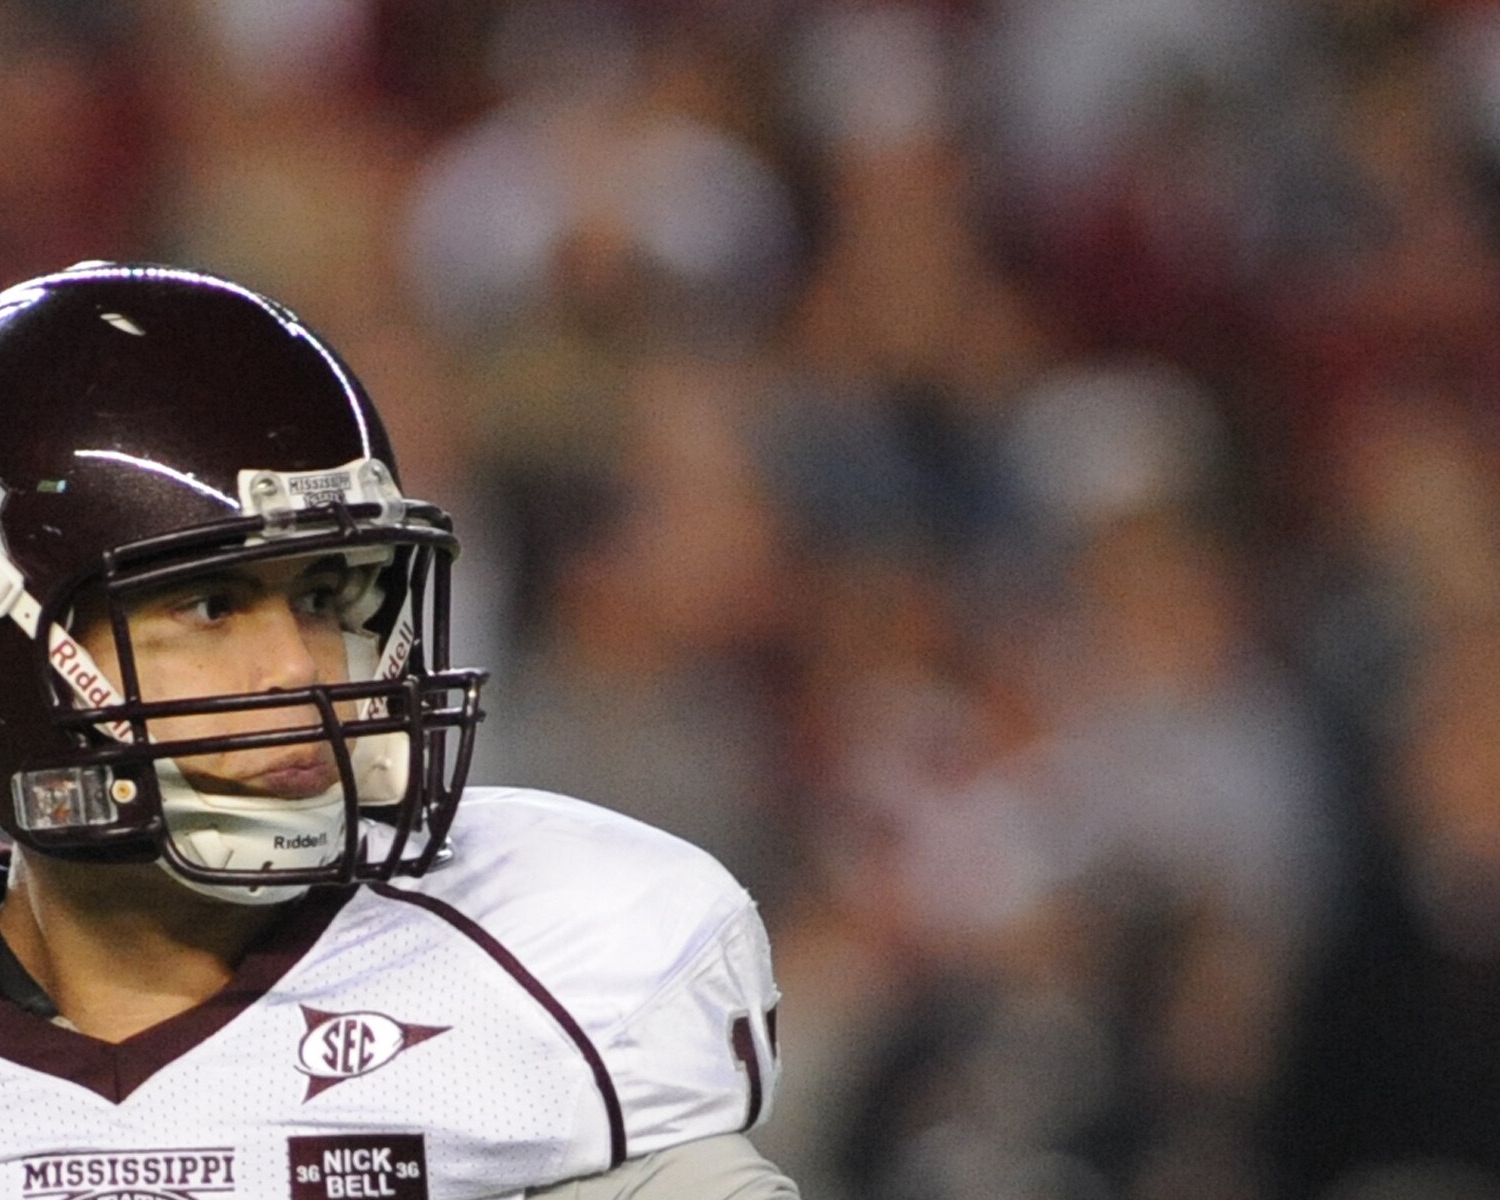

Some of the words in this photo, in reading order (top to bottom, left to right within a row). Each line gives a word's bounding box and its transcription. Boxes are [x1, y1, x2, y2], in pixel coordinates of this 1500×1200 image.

[274, 832, 328, 850] Riddell
[322, 1019, 376, 1074] SEC
[22, 1155, 236, 1191] MISSISSIPPI
[296, 1165, 321, 1183] 36
[323, 1147, 393, 1174] NICK
[395, 1161, 420, 1179] 36
[326, 1172, 396, 1199] BELL
